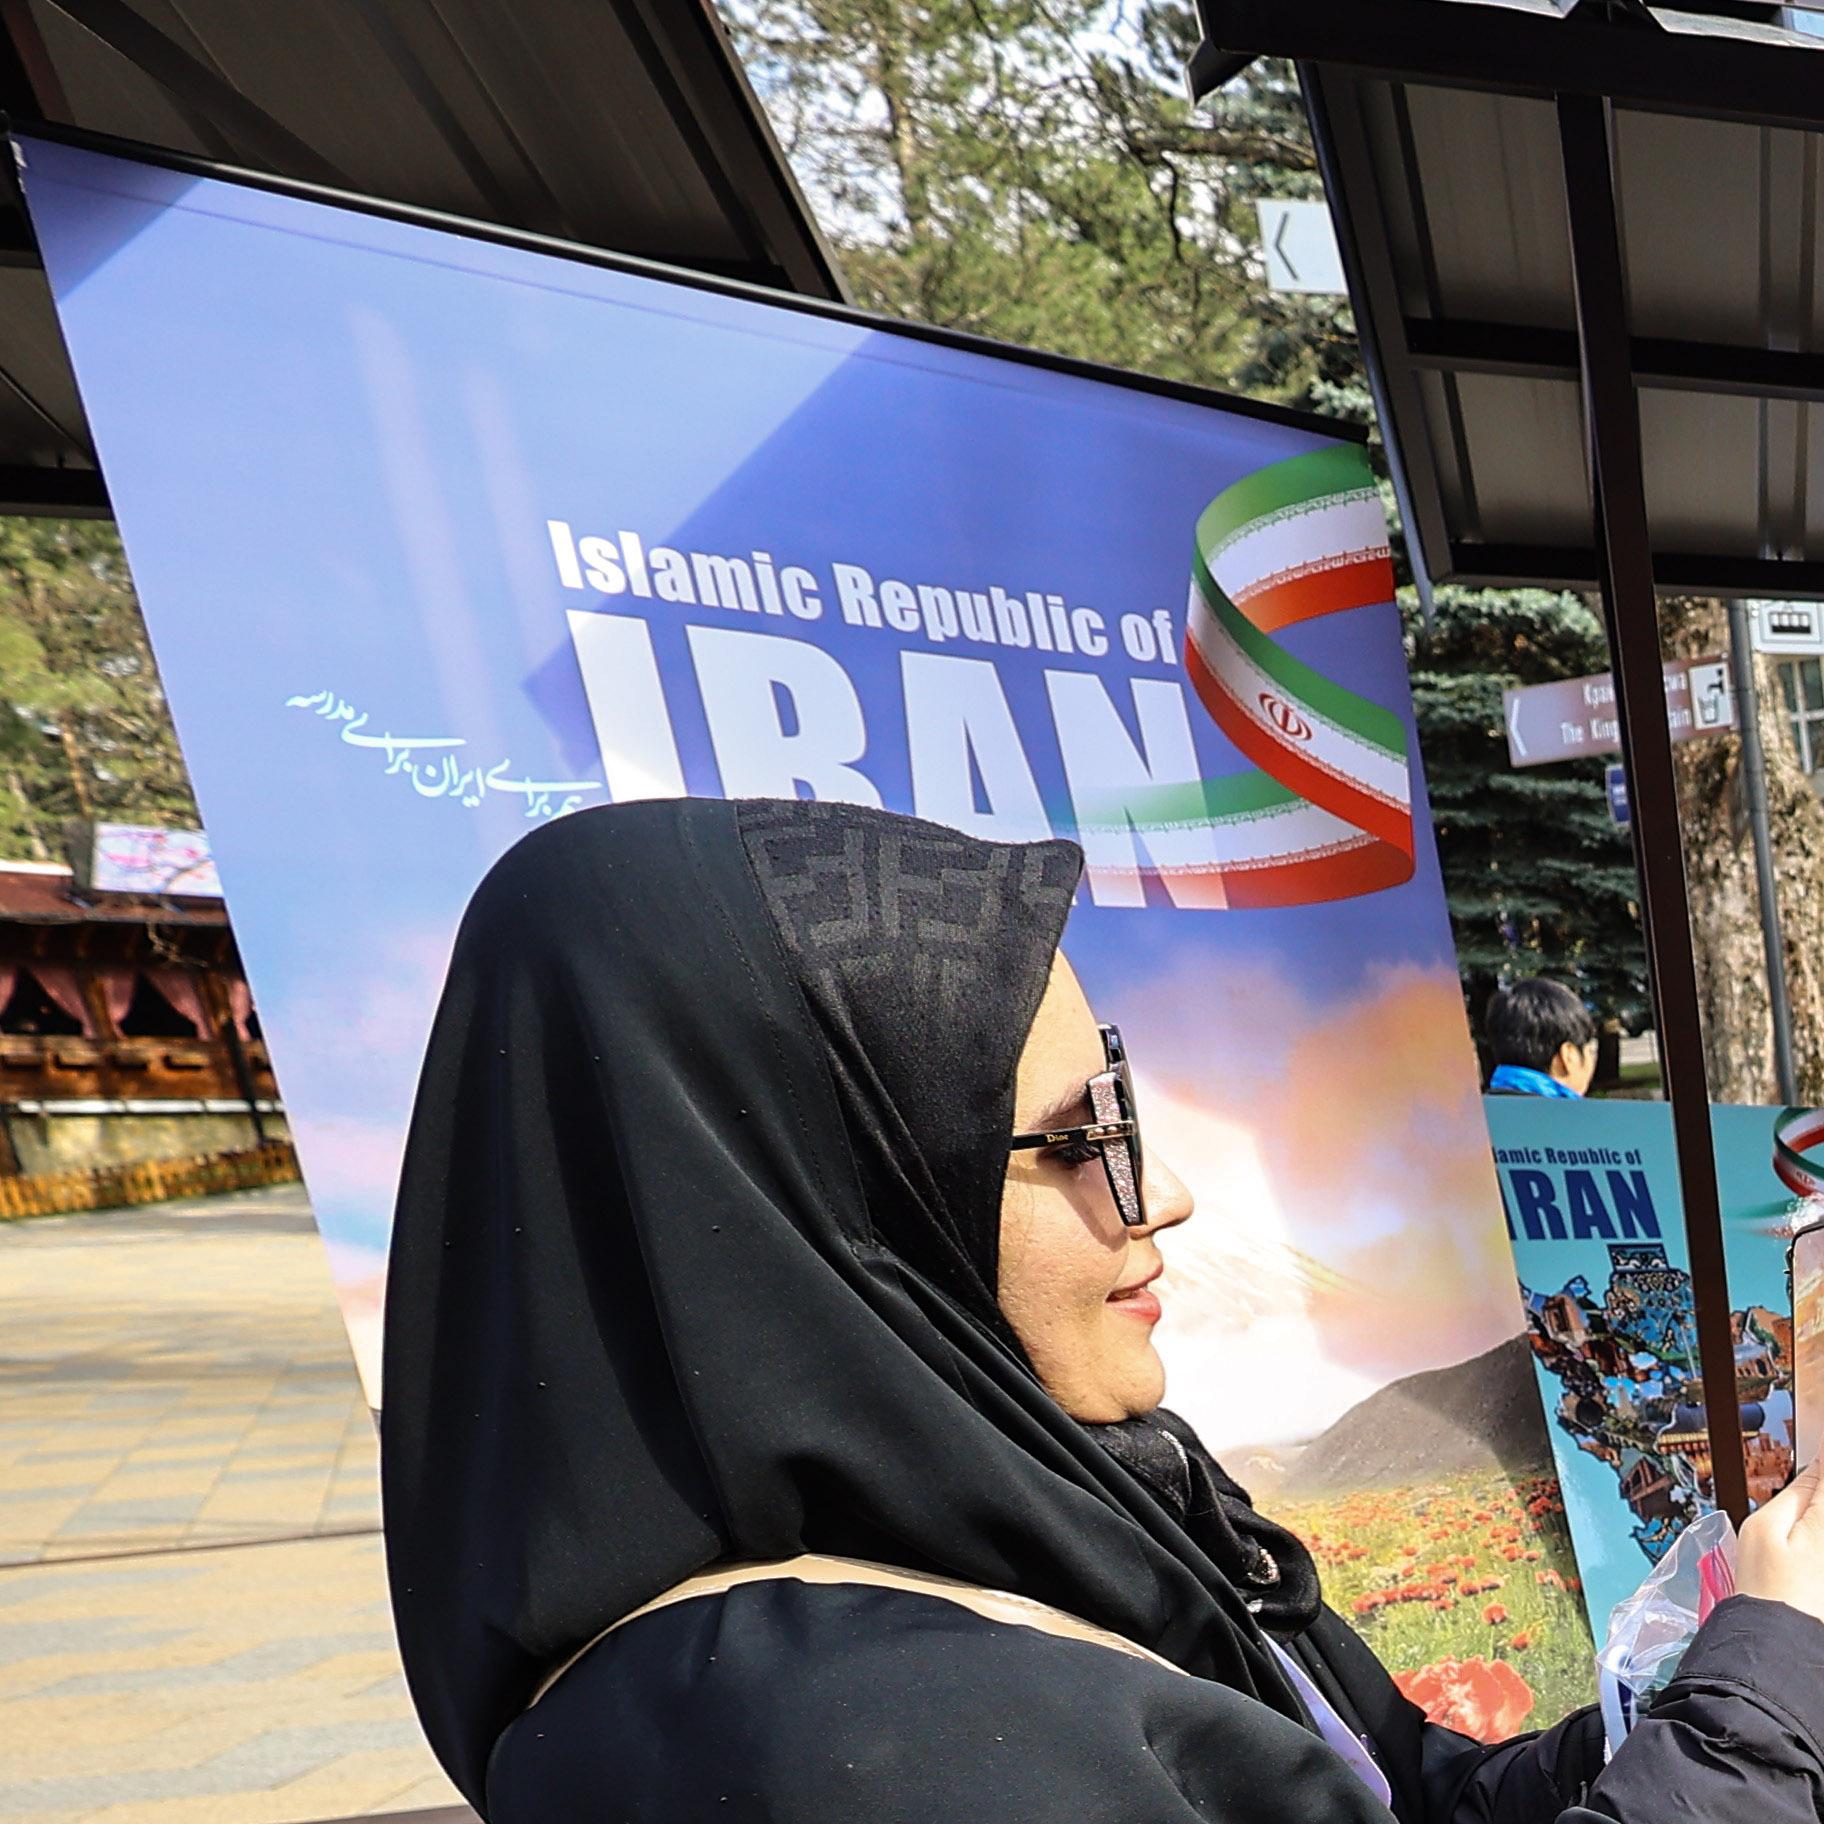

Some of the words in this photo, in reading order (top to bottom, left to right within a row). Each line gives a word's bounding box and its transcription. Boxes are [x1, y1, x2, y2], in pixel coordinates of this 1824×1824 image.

[547, 520, 821, 620] Islamic
[832, 562, 1107, 658] Republic
[1122, 607, 1178, 665] of
[565, 609, 1229, 911] IRAN
[1494, 1145, 1542, 1166] lamic
[1546, 1147, 1622, 1165] Republic
[1626, 1148, 1642, 1165] of
[1509, 1169, 1661, 1241] RAN
